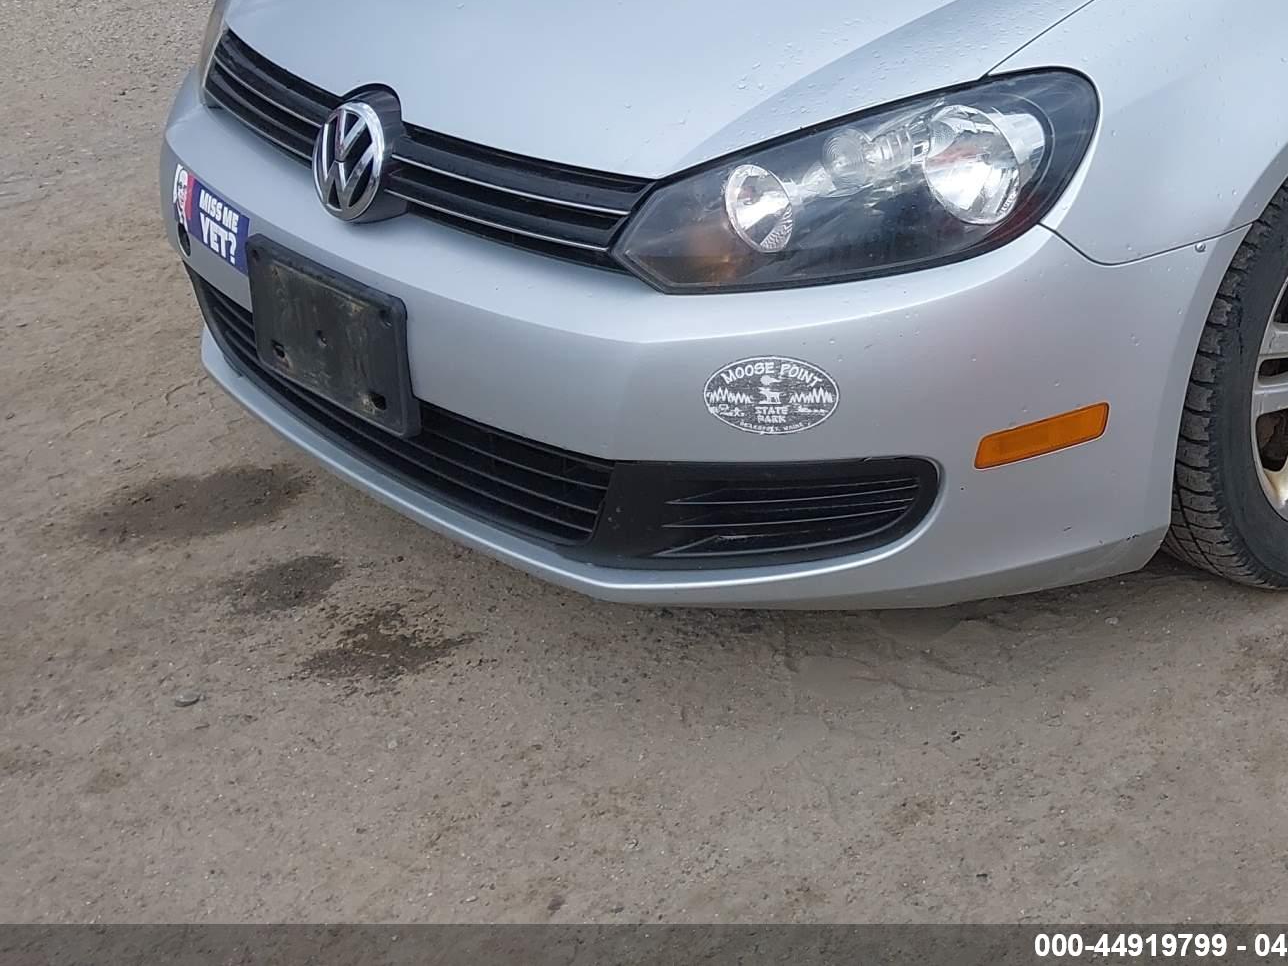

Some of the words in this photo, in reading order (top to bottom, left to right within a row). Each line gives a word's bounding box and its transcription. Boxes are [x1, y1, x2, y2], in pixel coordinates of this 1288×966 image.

[199, 189, 223, 221] MISS
[222, 205, 239, 234] ME
[200, 212, 237, 264] YET?
[720, 362, 775, 384] MOOSE
[779, 363, 823, 387] POINT
[755, 406, 788, 414] STATE
[757, 415, 786, 423] PARK
